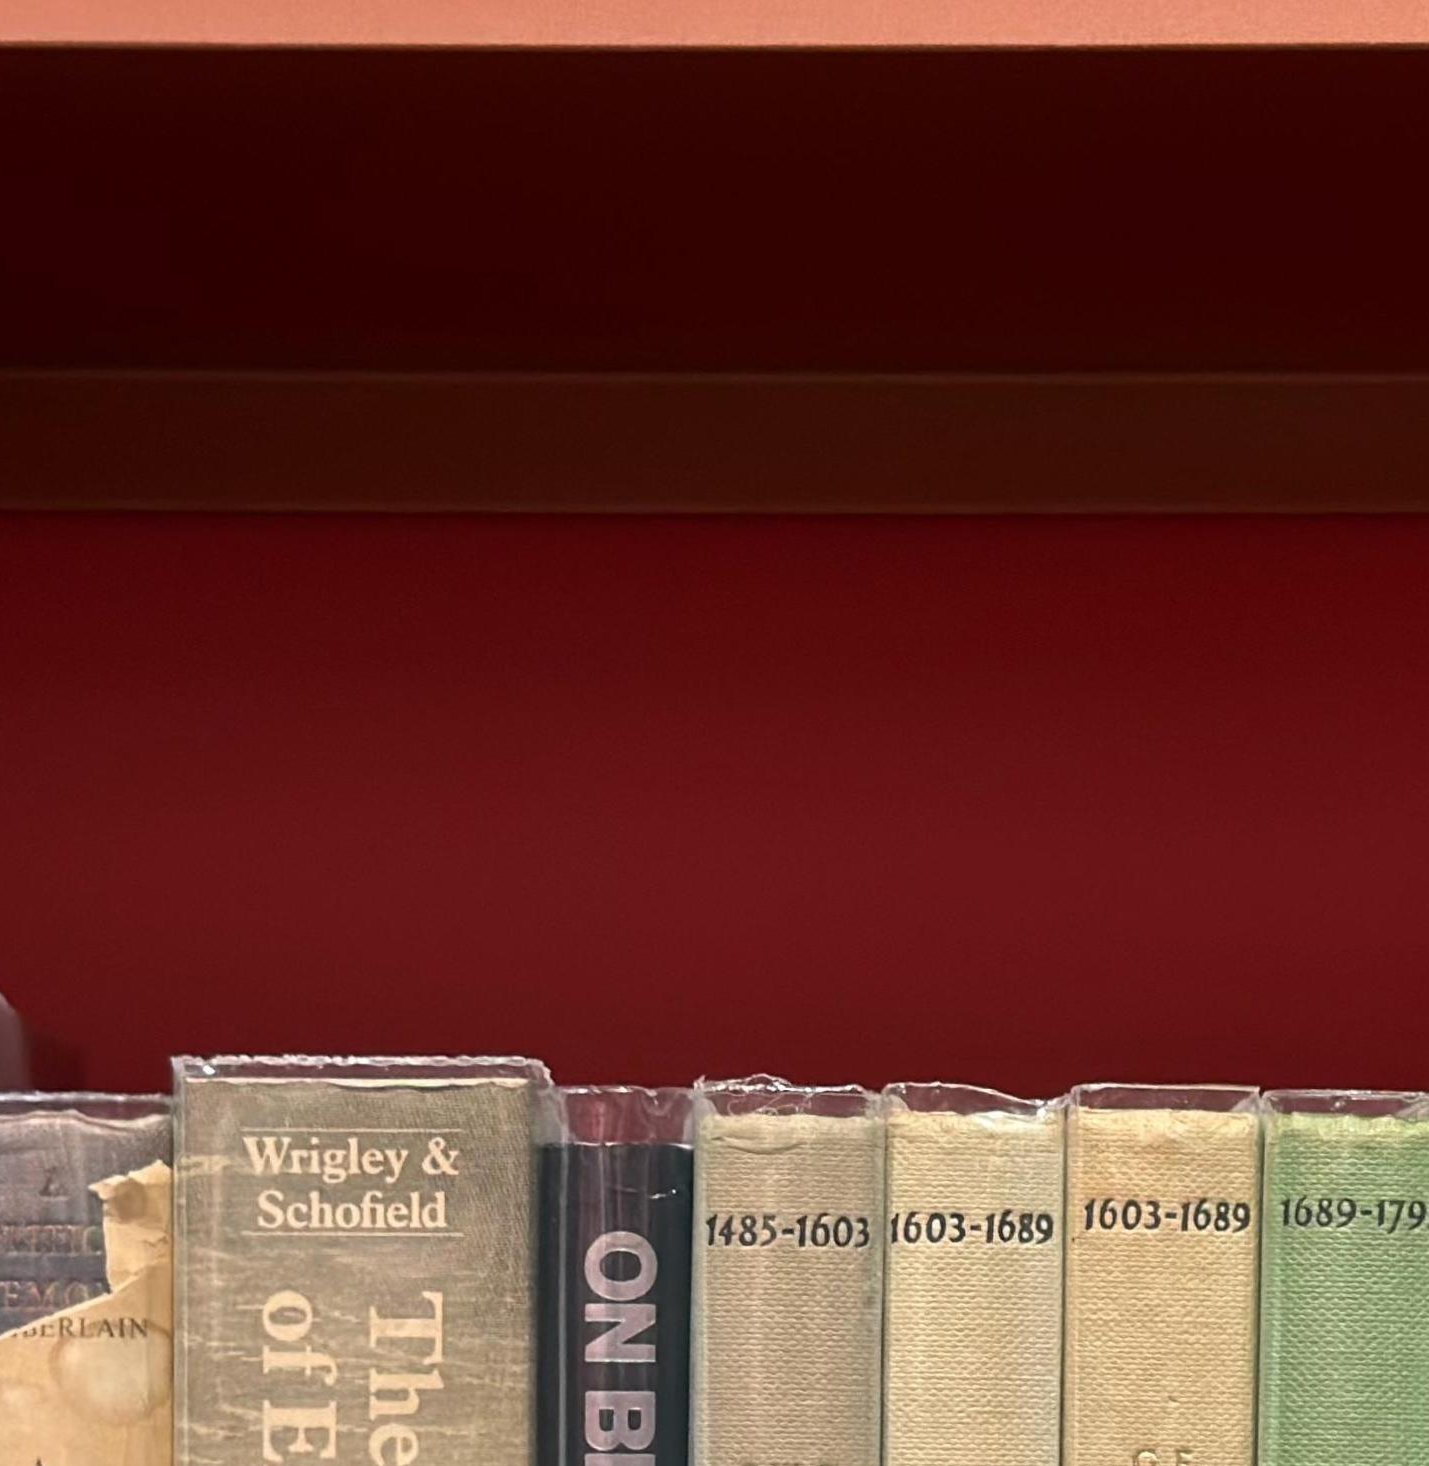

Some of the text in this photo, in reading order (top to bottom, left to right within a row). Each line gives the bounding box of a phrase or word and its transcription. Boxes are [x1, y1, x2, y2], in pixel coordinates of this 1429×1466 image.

[243, 1136, 460, 1183] Wrigley &
[257, 1189, 447, 1229] Schofield
[891, 1211, 1054, 1245] 1603-1689
[1084, 1199, 1251, 1233] 1603-1689
[706, 1213, 870, 1248] 1485-1603
[583, 1231, 658, 1364] ON
[261, 1290, 337, 1387] of
